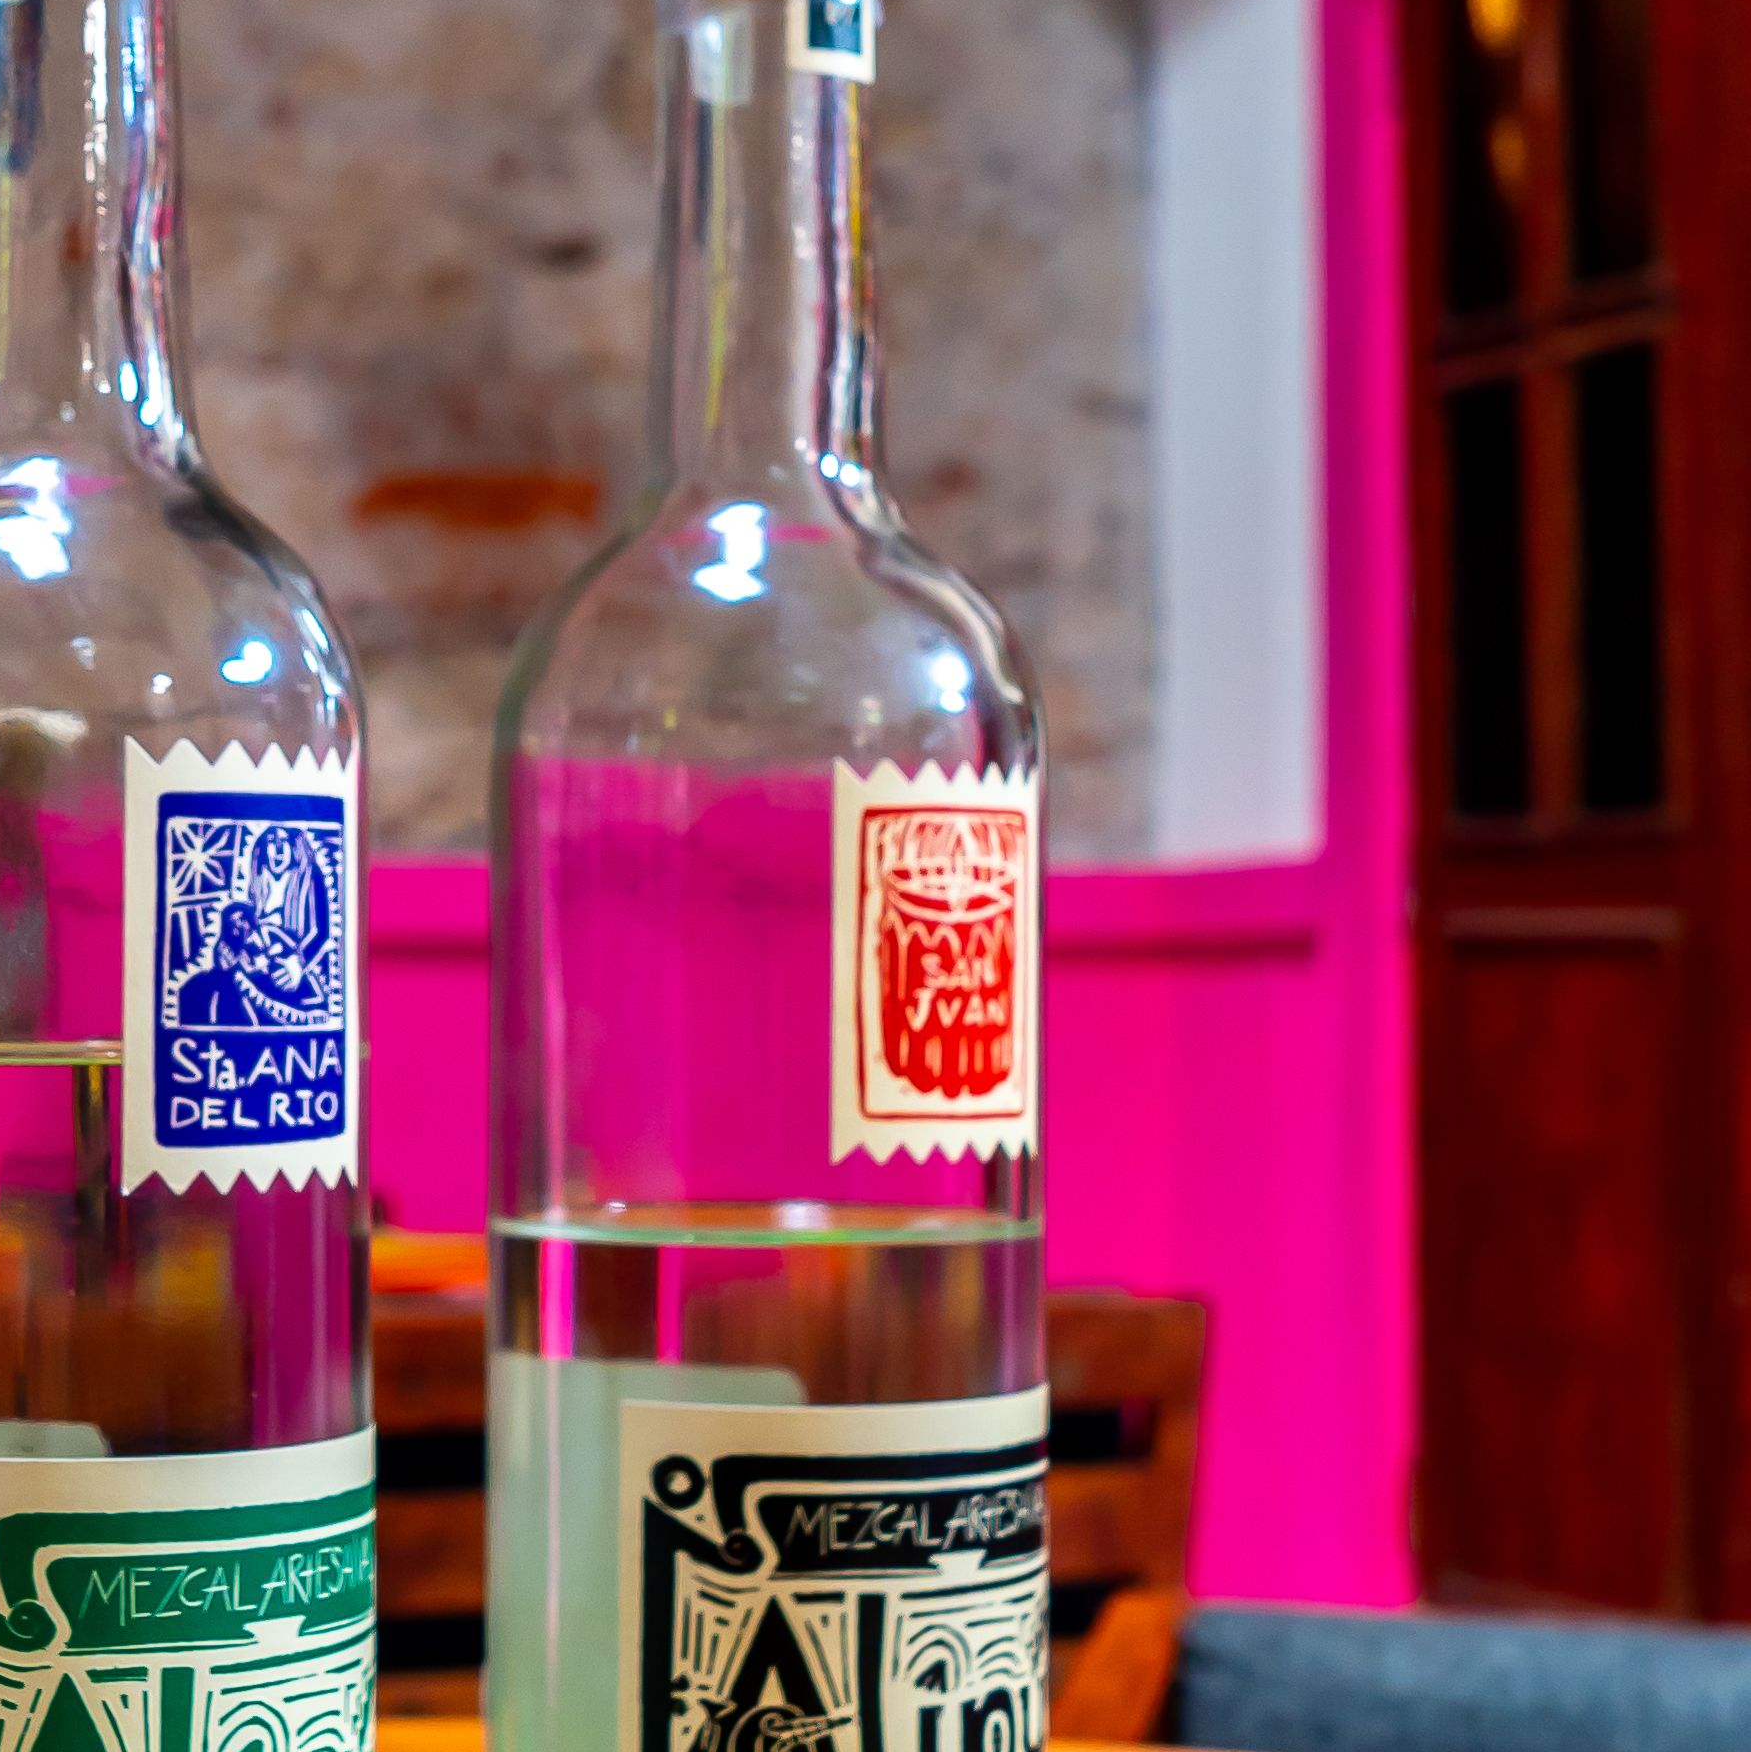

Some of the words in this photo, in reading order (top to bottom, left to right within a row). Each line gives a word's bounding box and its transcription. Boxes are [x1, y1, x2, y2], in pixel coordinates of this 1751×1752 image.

[919, 953, 996, 990] SAN
[170, 1094, 260, 1131] DEL
[268, 1089, 339, 1127] RIO
[783, 1500, 945, 1557] MEZCAL
[77, 1560, 257, 1627] MEZCAL
